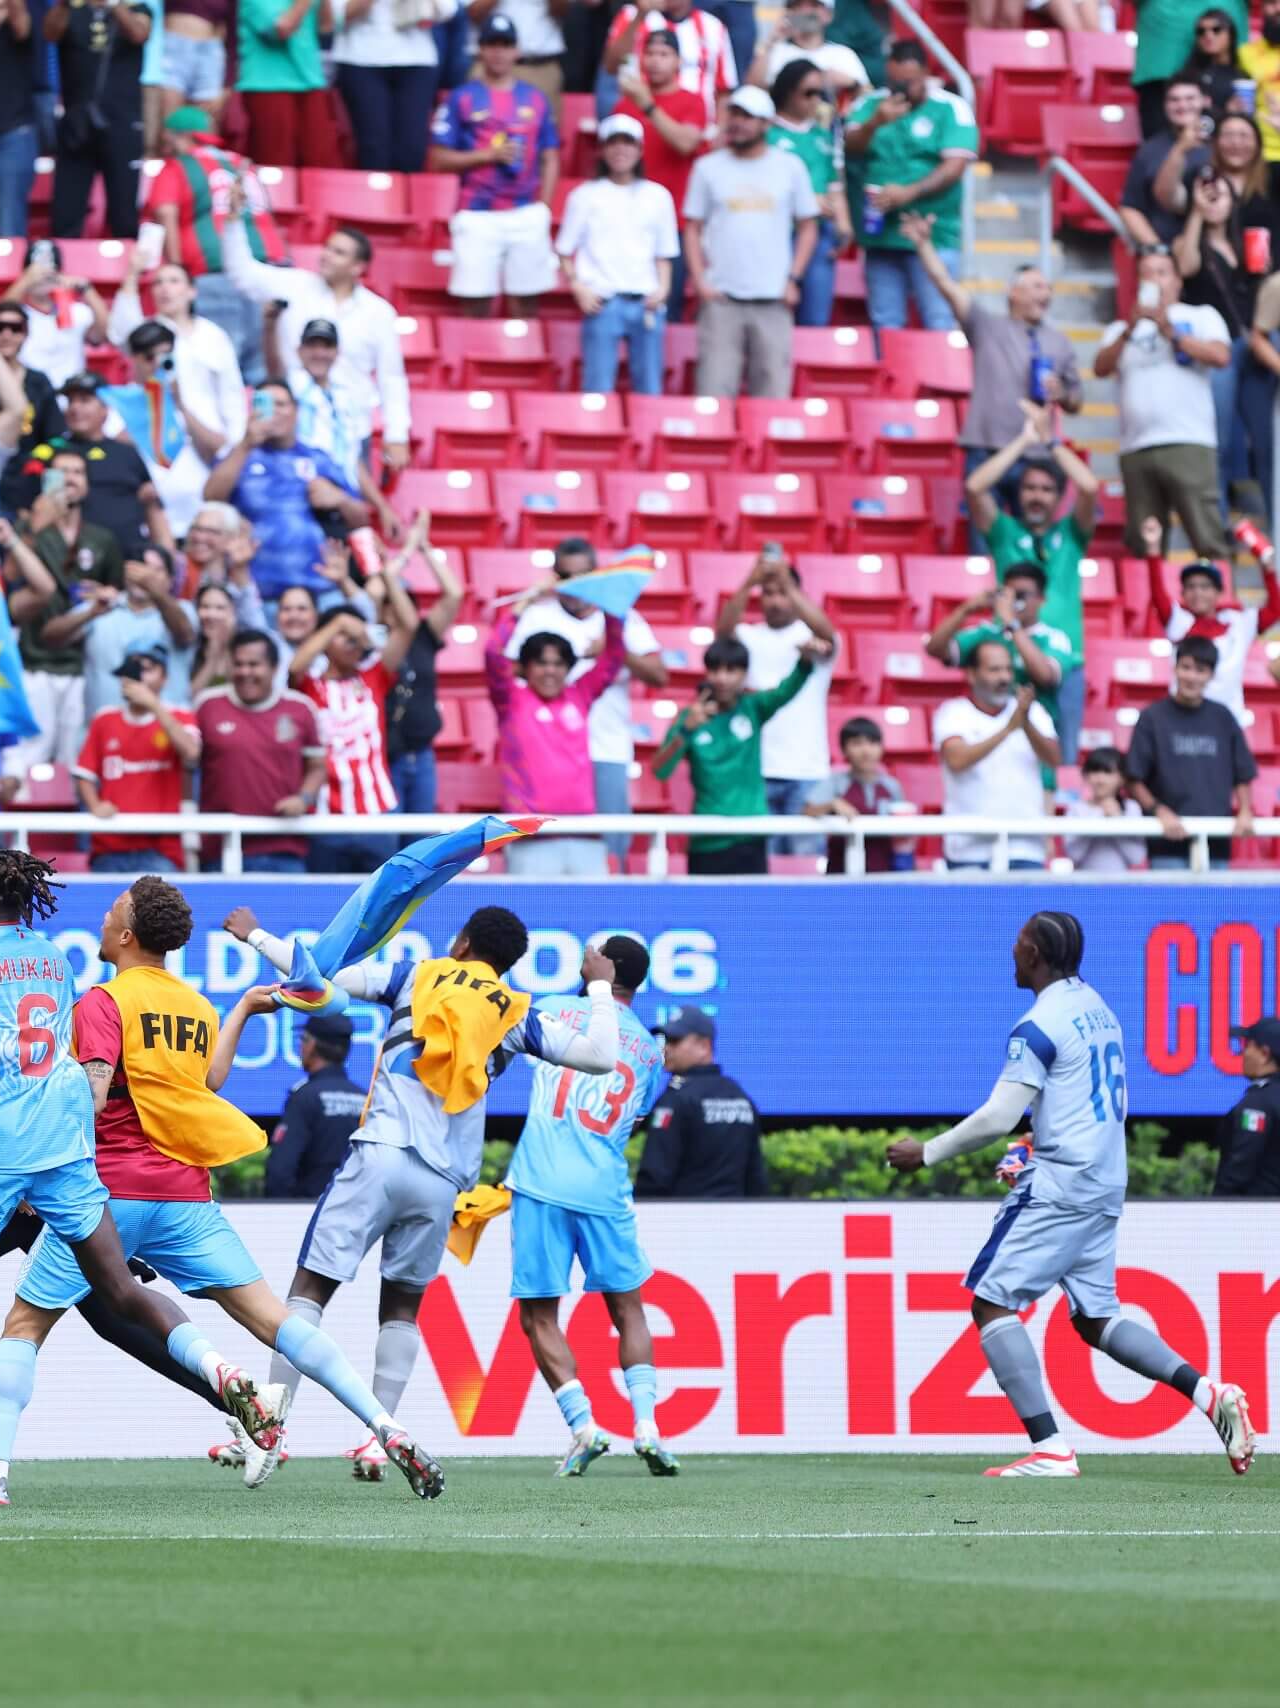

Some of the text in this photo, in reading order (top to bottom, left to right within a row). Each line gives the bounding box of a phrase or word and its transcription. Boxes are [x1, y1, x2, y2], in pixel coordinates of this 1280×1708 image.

[16, 992, 58, 1079] 6
[139, 1012, 210, 1058] FIFA
[1145, 922, 1280, 1076] CO
[552, 1060, 636, 1136] 13
[1088, 1041, 1124, 1123] 16
